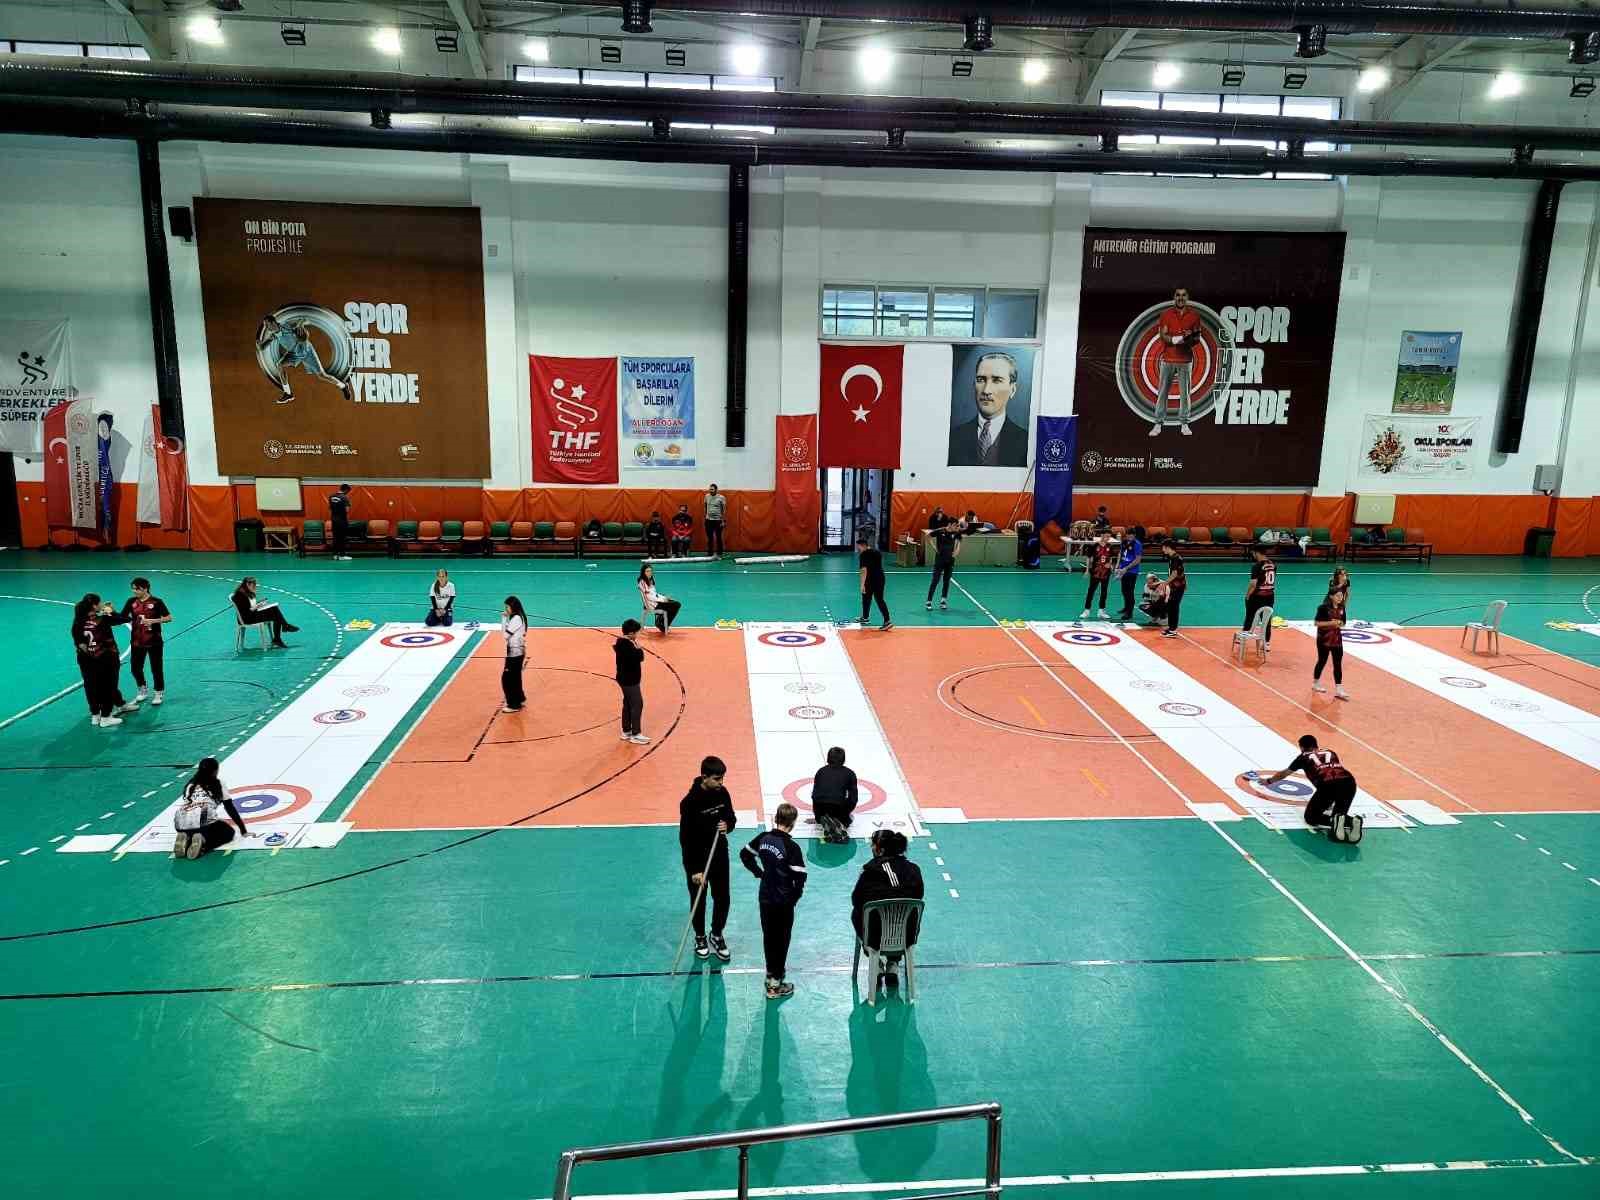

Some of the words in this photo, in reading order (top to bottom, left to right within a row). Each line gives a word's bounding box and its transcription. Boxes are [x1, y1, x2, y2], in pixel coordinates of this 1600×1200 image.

[244, 220, 260, 235] ON
[261, 219, 280, 235] BİN
[281, 222, 307, 236] POTA
[344, 301, 409, 334] SPOR
[1219, 305, 1291, 343] SPOR
[347, 337, 392, 369] HER
[623, 360, 640, 373] TÜM
[640, 362, 691, 373] SPORCULARA
[1215, 347, 1265, 384] HER
[349, 372, 420, 404] YERDE
[636, 379, 679, 391] BAŞARILAR
[643, 393, 674, 406] DİLERİM
[1213, 388, 1292, 425] YERDE
[0, 409, 37, 421] SÜPER
[549, 430, 601, 450] THF
[1265, 570, 1275, 585] 10
[84, 630, 97, 645] 2
[1309, 751, 1332, 767] 17
